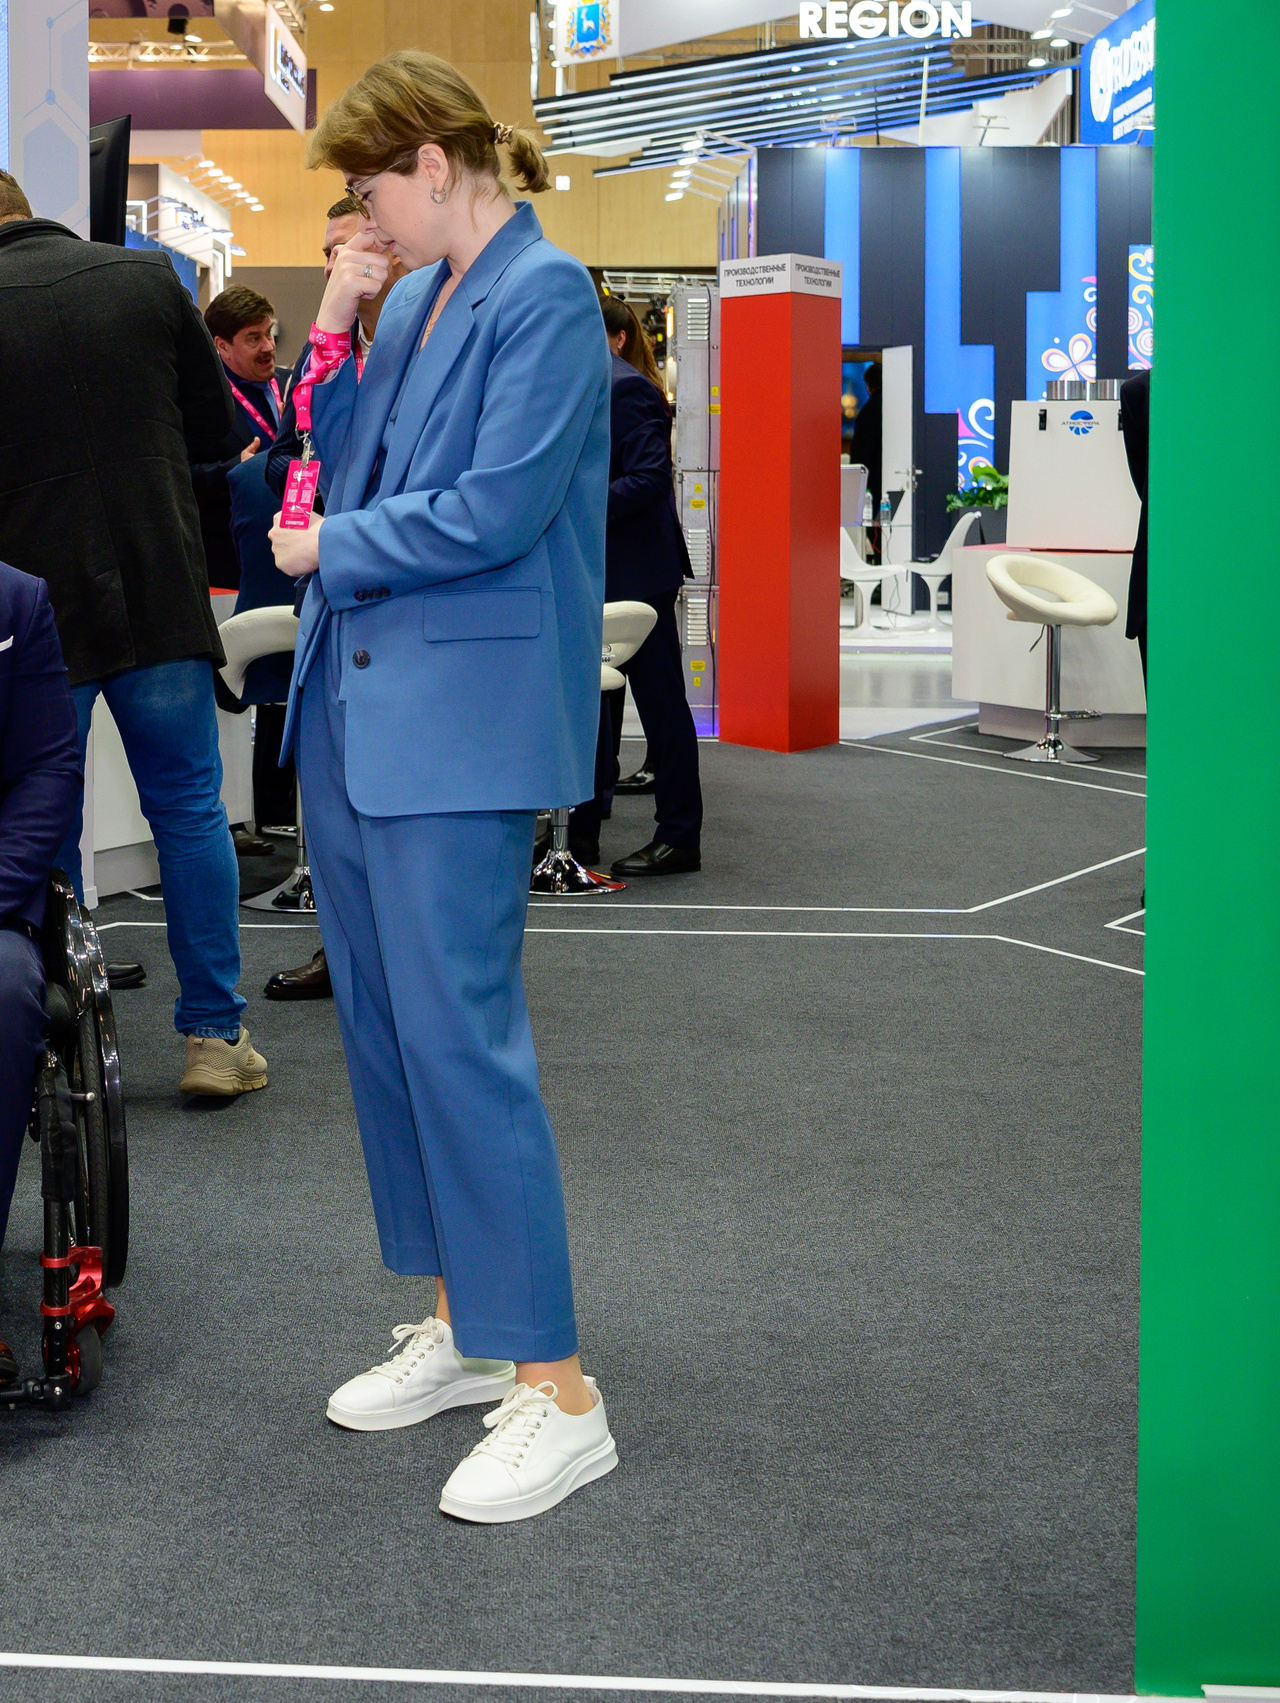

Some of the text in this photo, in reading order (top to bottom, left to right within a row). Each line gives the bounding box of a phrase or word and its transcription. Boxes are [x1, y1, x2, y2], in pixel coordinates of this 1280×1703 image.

[799, 0, 972, 39] REGION
[724, 263, 787, 277] ПРОИЗВОДСТВЕННЫЕ
[795, 262, 841, 279] ПРОИЗВОДСТВЕННЫЕ
[735, 276, 774, 288] ТЕХНОЛОГИИ
[804, 276, 832, 288] ТЕХНОЛОГИИ
